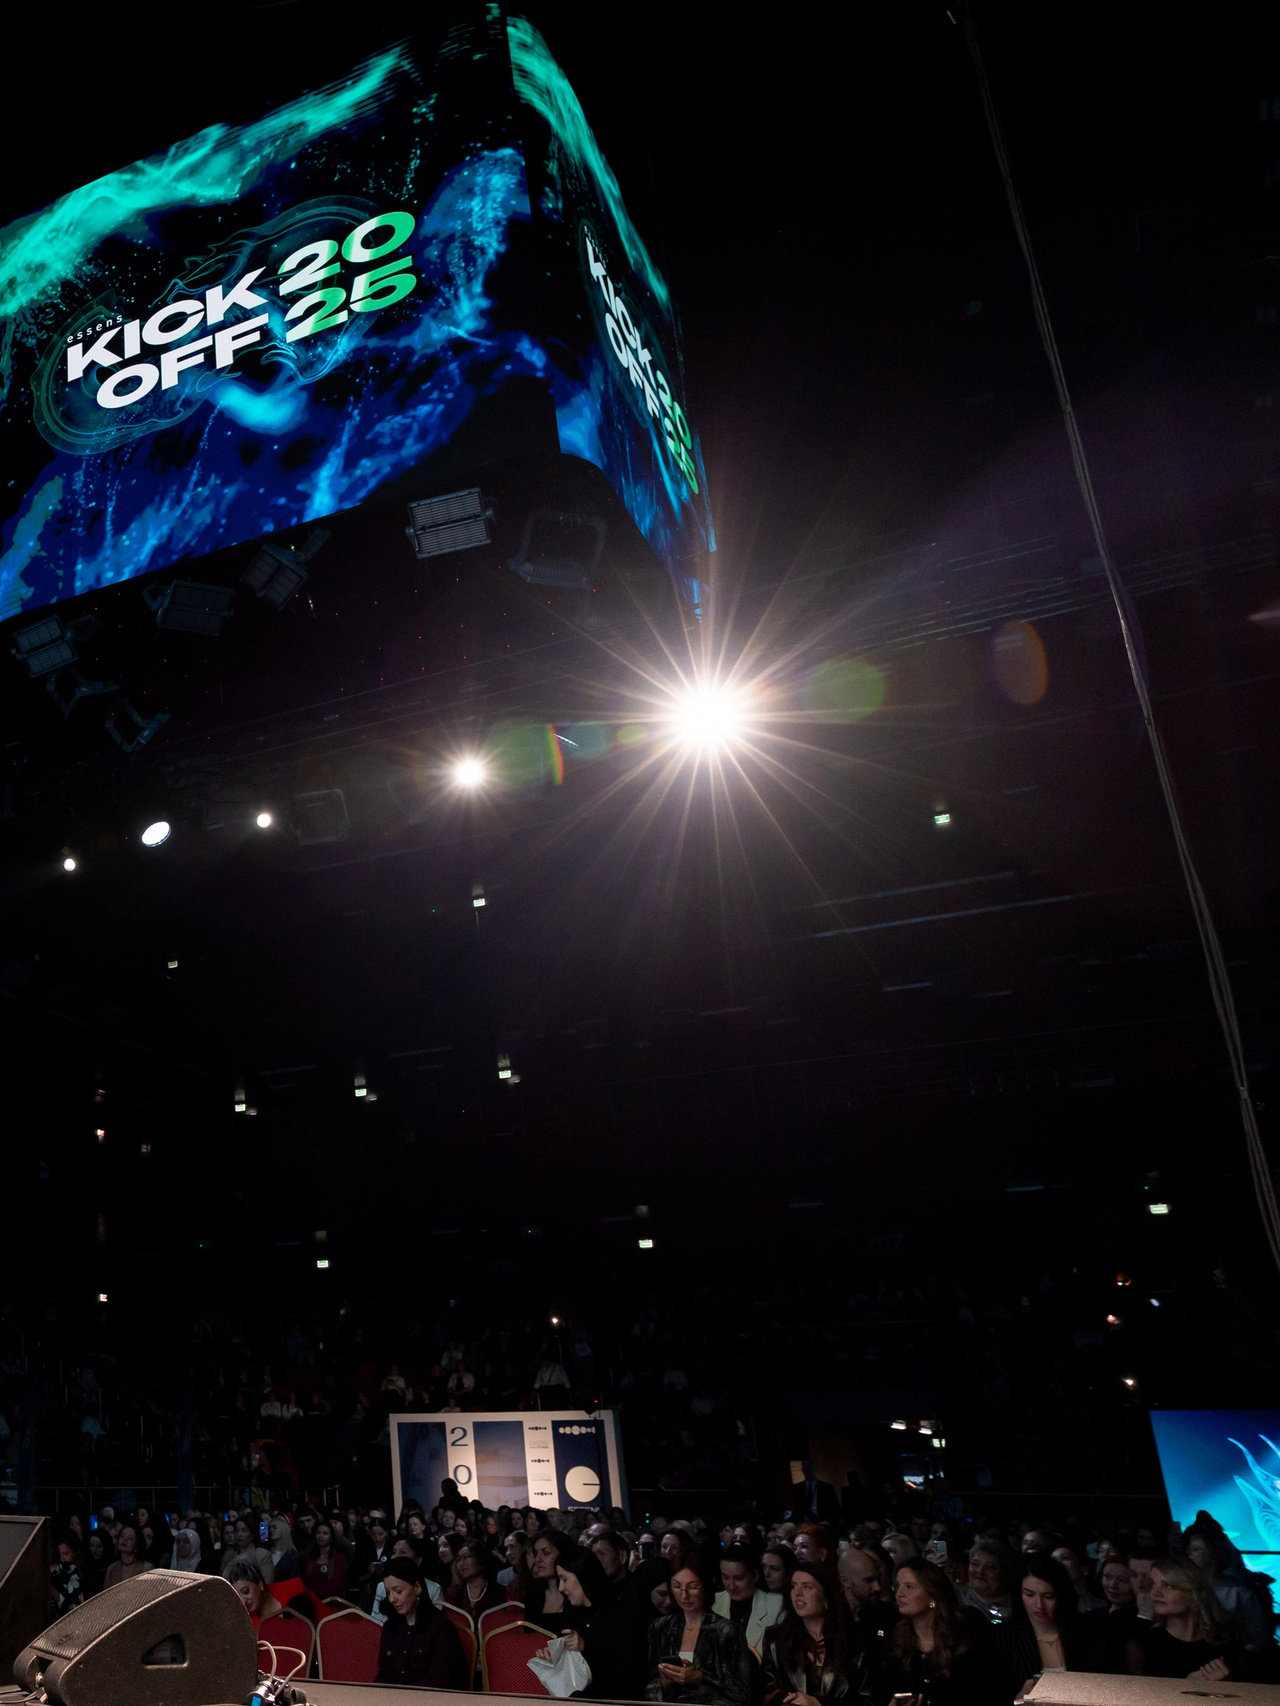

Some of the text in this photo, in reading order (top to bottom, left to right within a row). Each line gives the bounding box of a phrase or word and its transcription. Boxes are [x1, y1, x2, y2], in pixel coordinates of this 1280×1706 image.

[67, 211, 416, 382] KICK 20
[67, 314, 123, 343] essens
[96, 256, 417, 409] OFF 25
[586, 237, 657, 391] KICK
[605, 313, 659, 419] OFF
